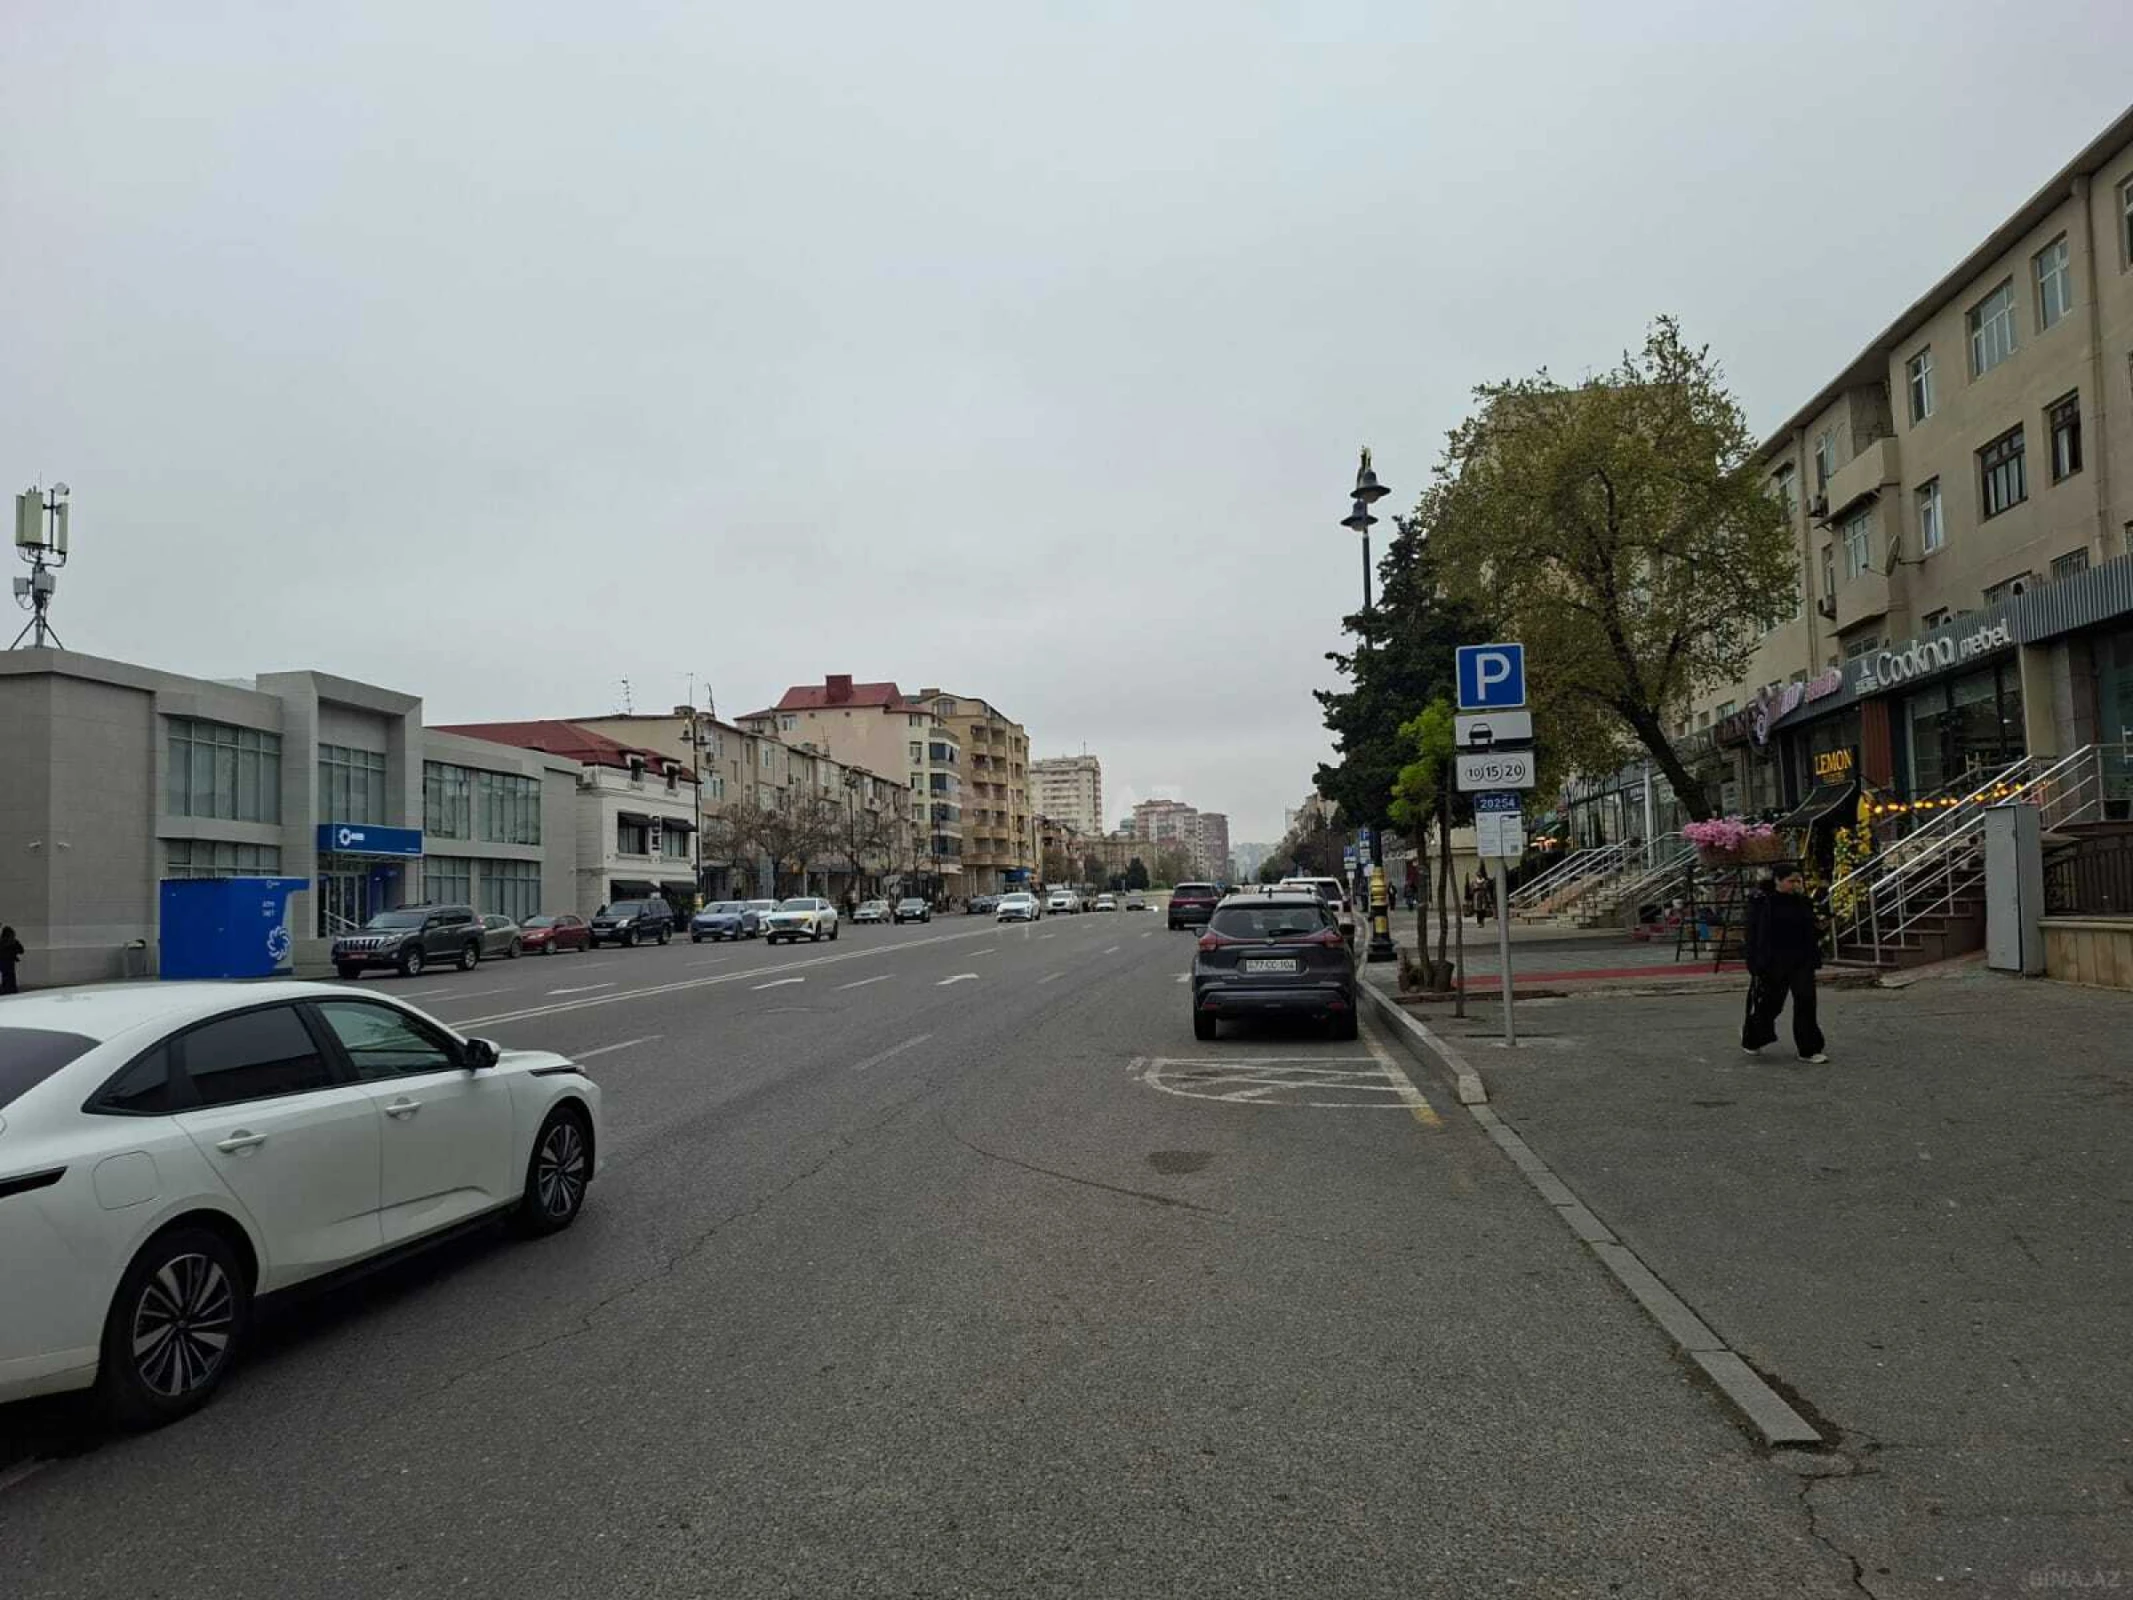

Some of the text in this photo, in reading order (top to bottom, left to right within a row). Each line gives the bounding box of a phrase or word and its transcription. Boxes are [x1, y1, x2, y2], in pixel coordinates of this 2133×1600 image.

[1959, 618, 2012, 658] mebel
[1476, 652, 1511, 701] P
[1468, 764, 1522, 778] 10 15 20
[1814, 747, 1853, 776] LEMON
[1479, 798, 1516, 809] 20254
